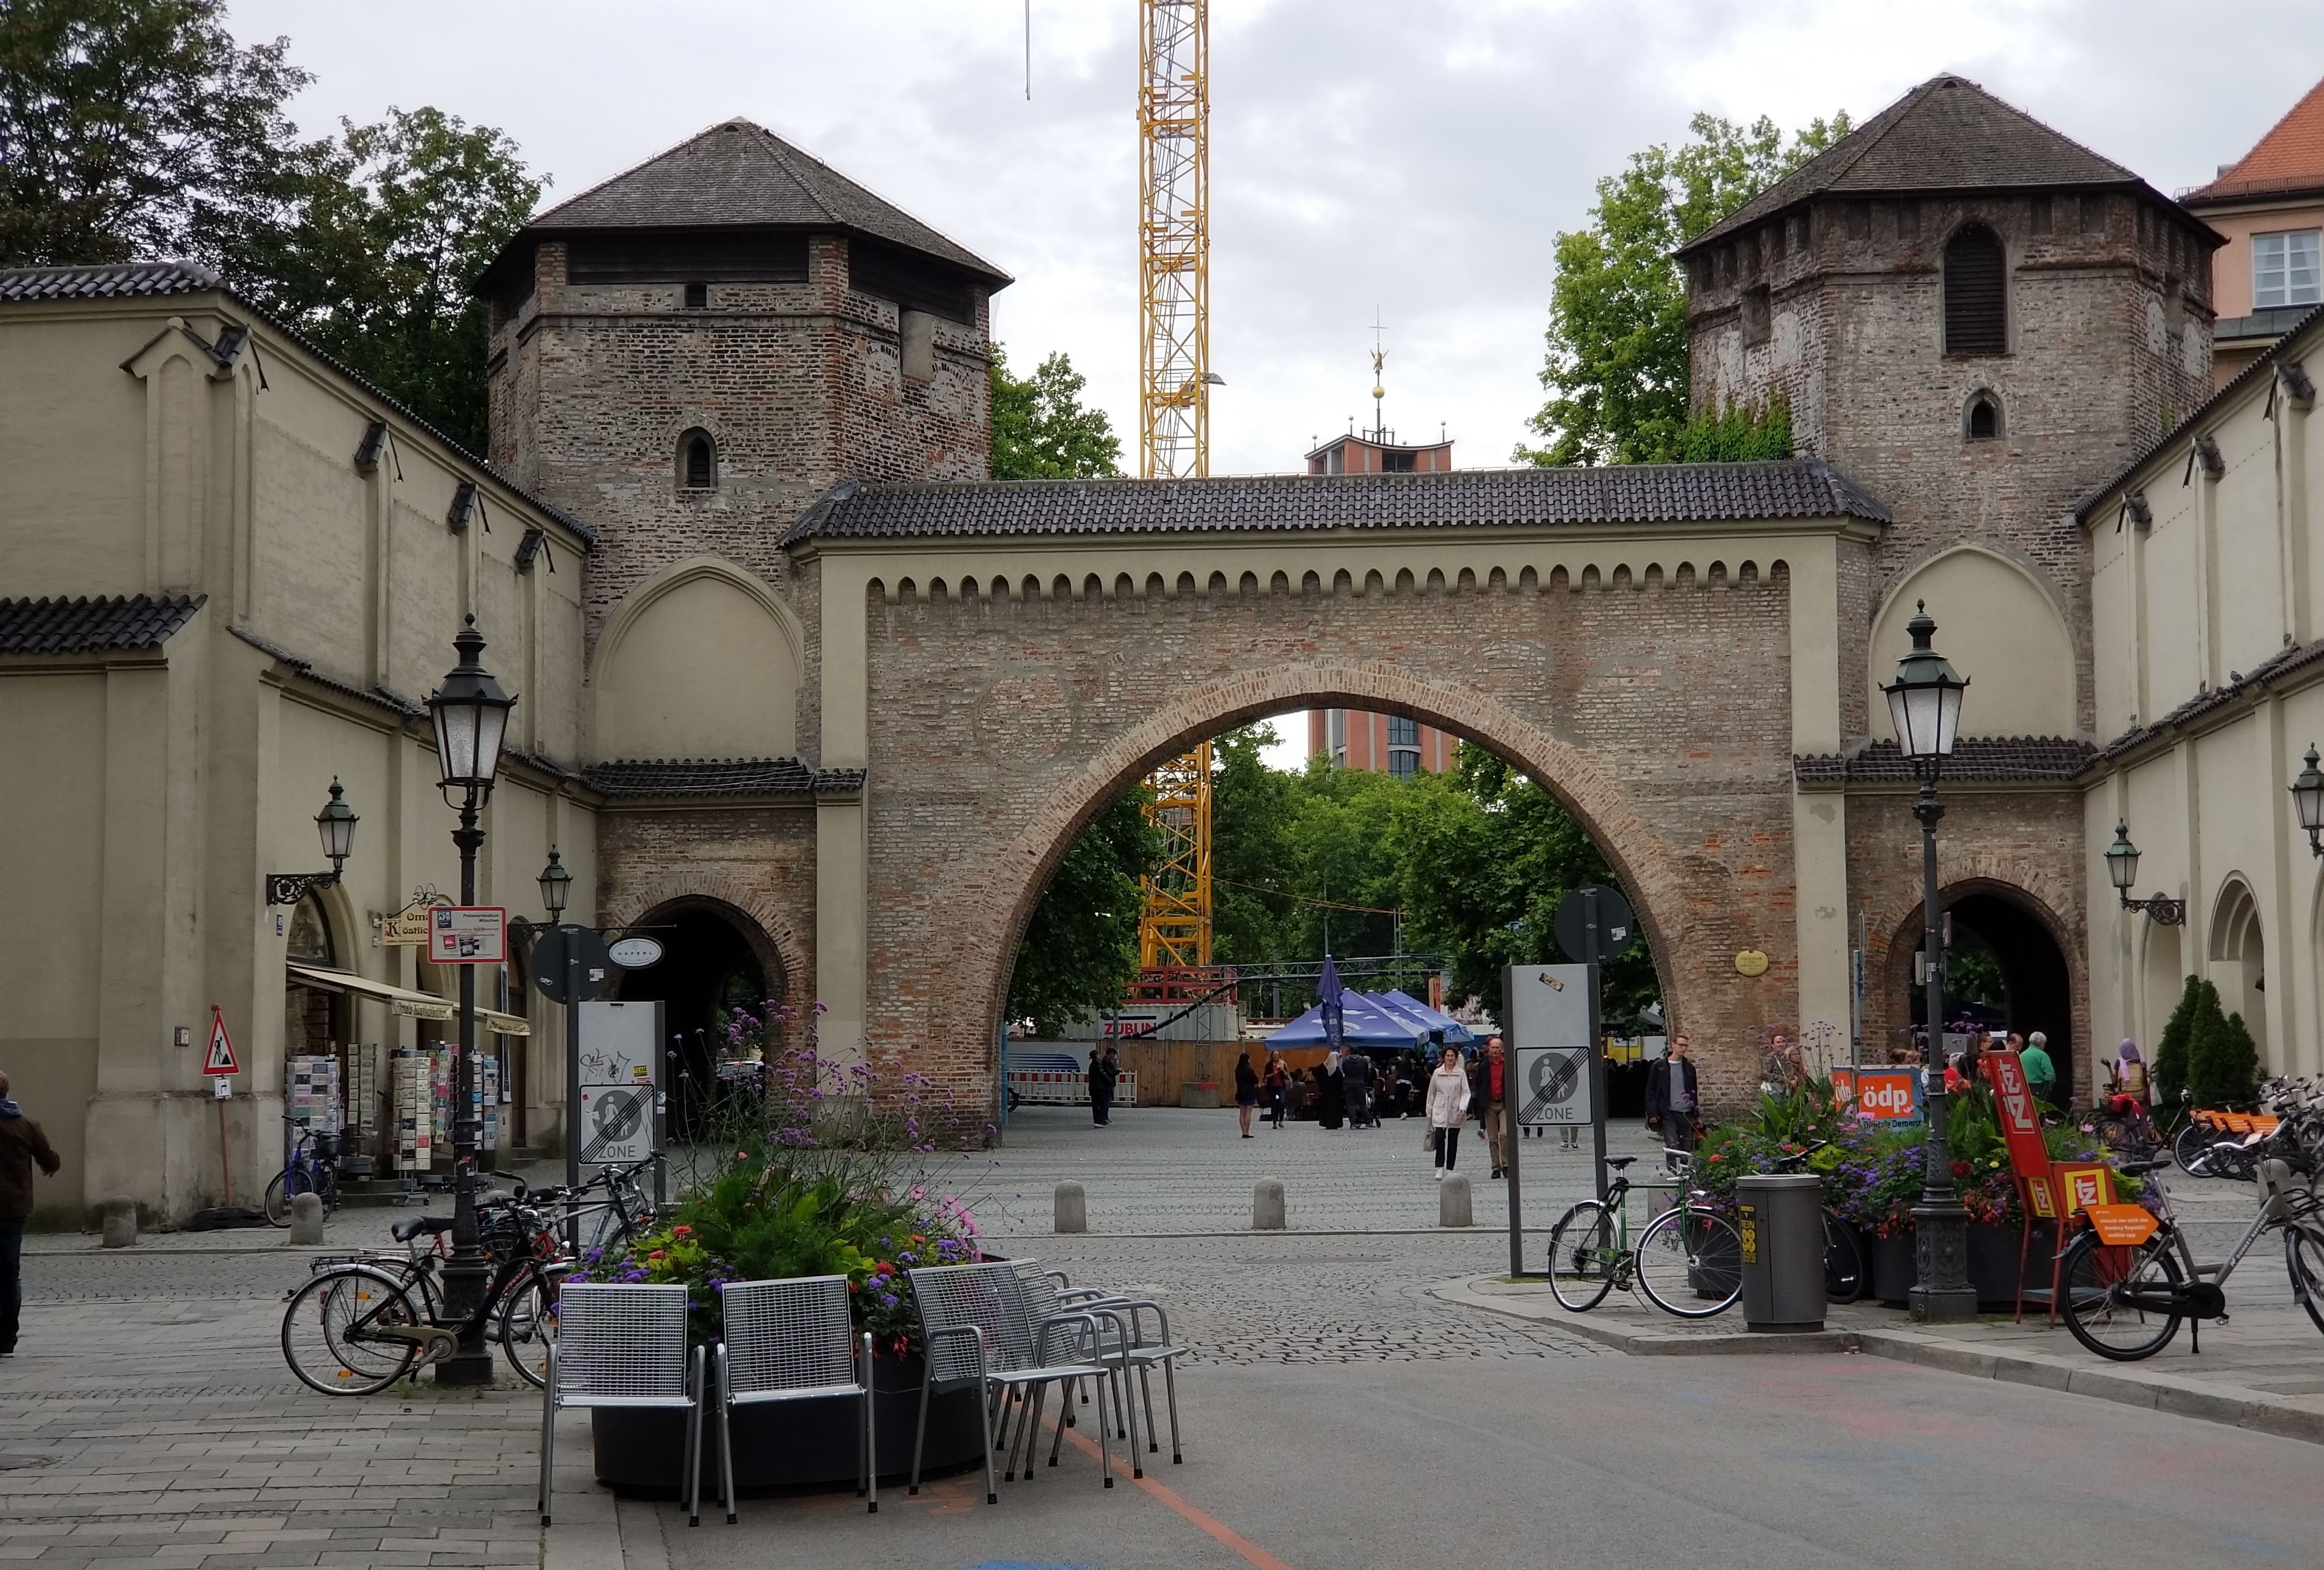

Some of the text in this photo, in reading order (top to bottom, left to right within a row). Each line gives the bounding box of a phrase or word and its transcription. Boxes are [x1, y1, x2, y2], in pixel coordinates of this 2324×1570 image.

[1863, 1084, 1907, 1113] ödp
[1537, 1108, 1574, 1120] ZONE
[599, 1145, 636, 1158] ZONE
[2034, 1183, 2048, 1209] tz
[2076, 1179, 2097, 1205] tz
[2236, 1213, 2270, 1259] DONKEY REPUBLIC
